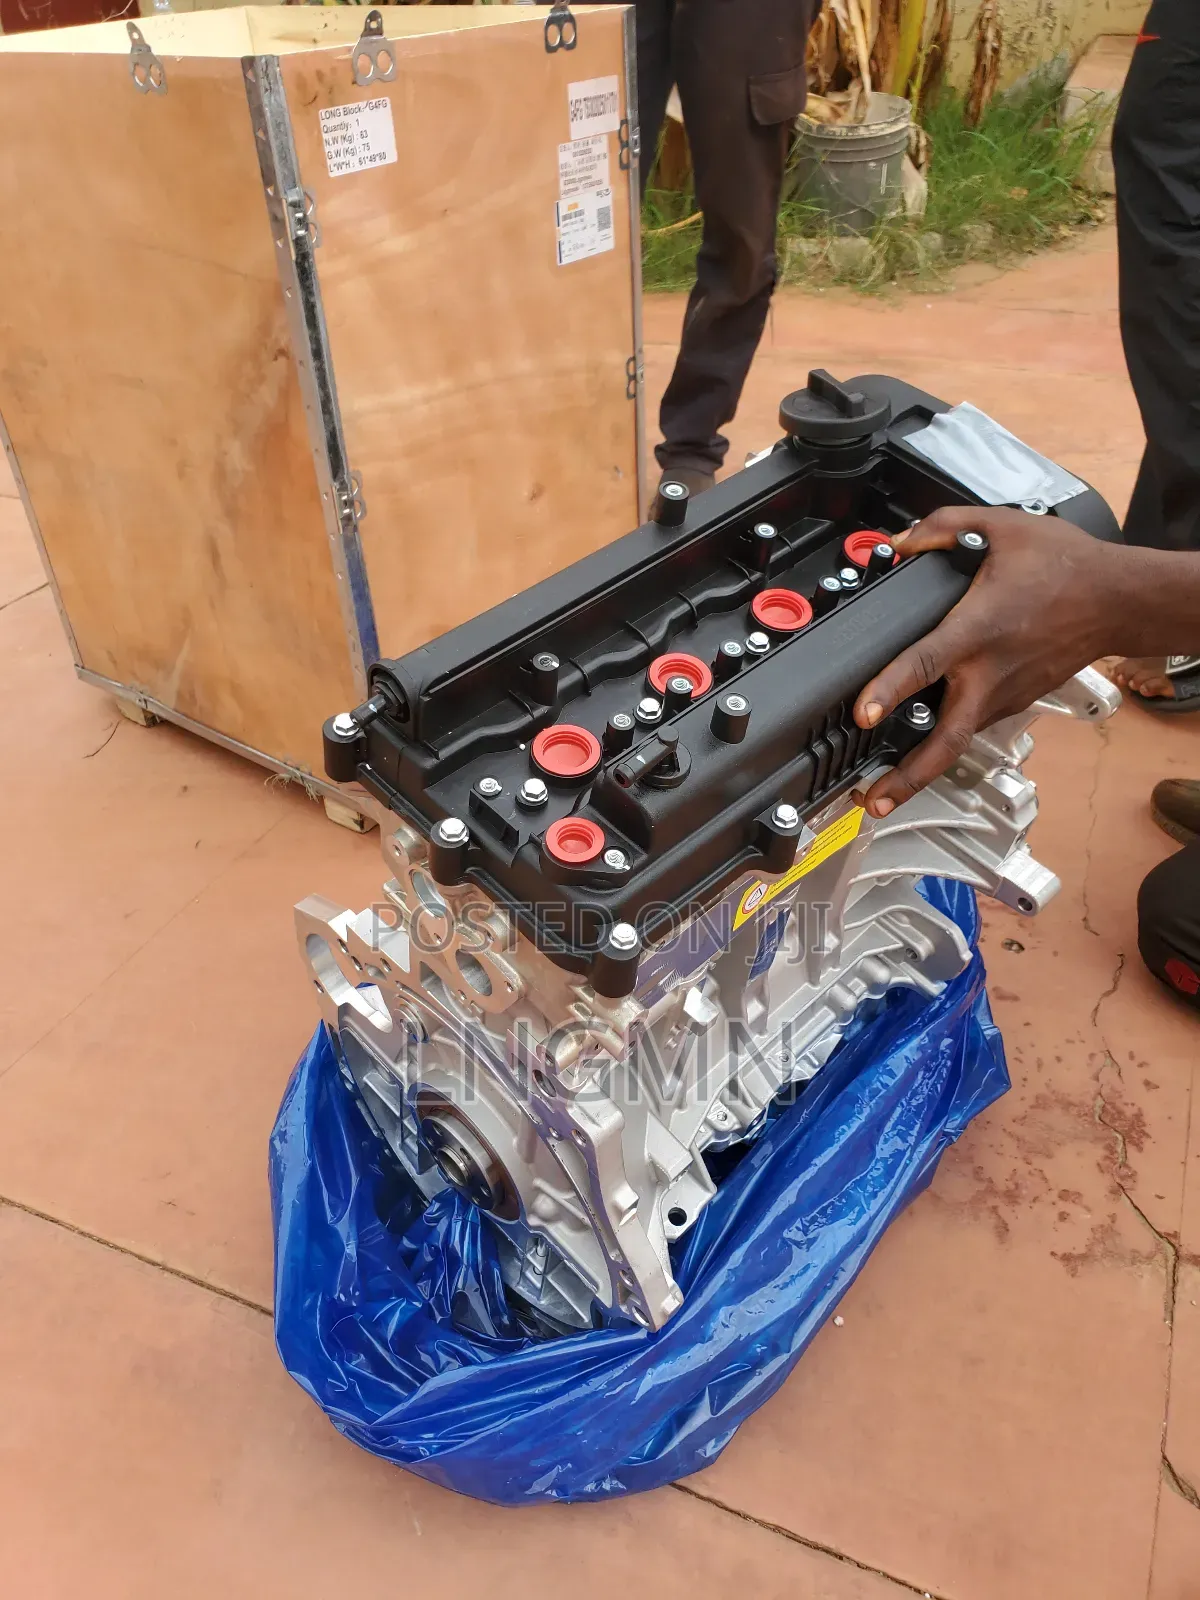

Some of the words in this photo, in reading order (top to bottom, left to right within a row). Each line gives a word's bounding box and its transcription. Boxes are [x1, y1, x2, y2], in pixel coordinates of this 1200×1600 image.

[320, 108, 342, 121] LONG
[368, 99, 388, 111] G4FG
[355, 118, 360, 127] 1
[327, 147, 342, 160] G.W
[361, 142, 371, 152] 75
